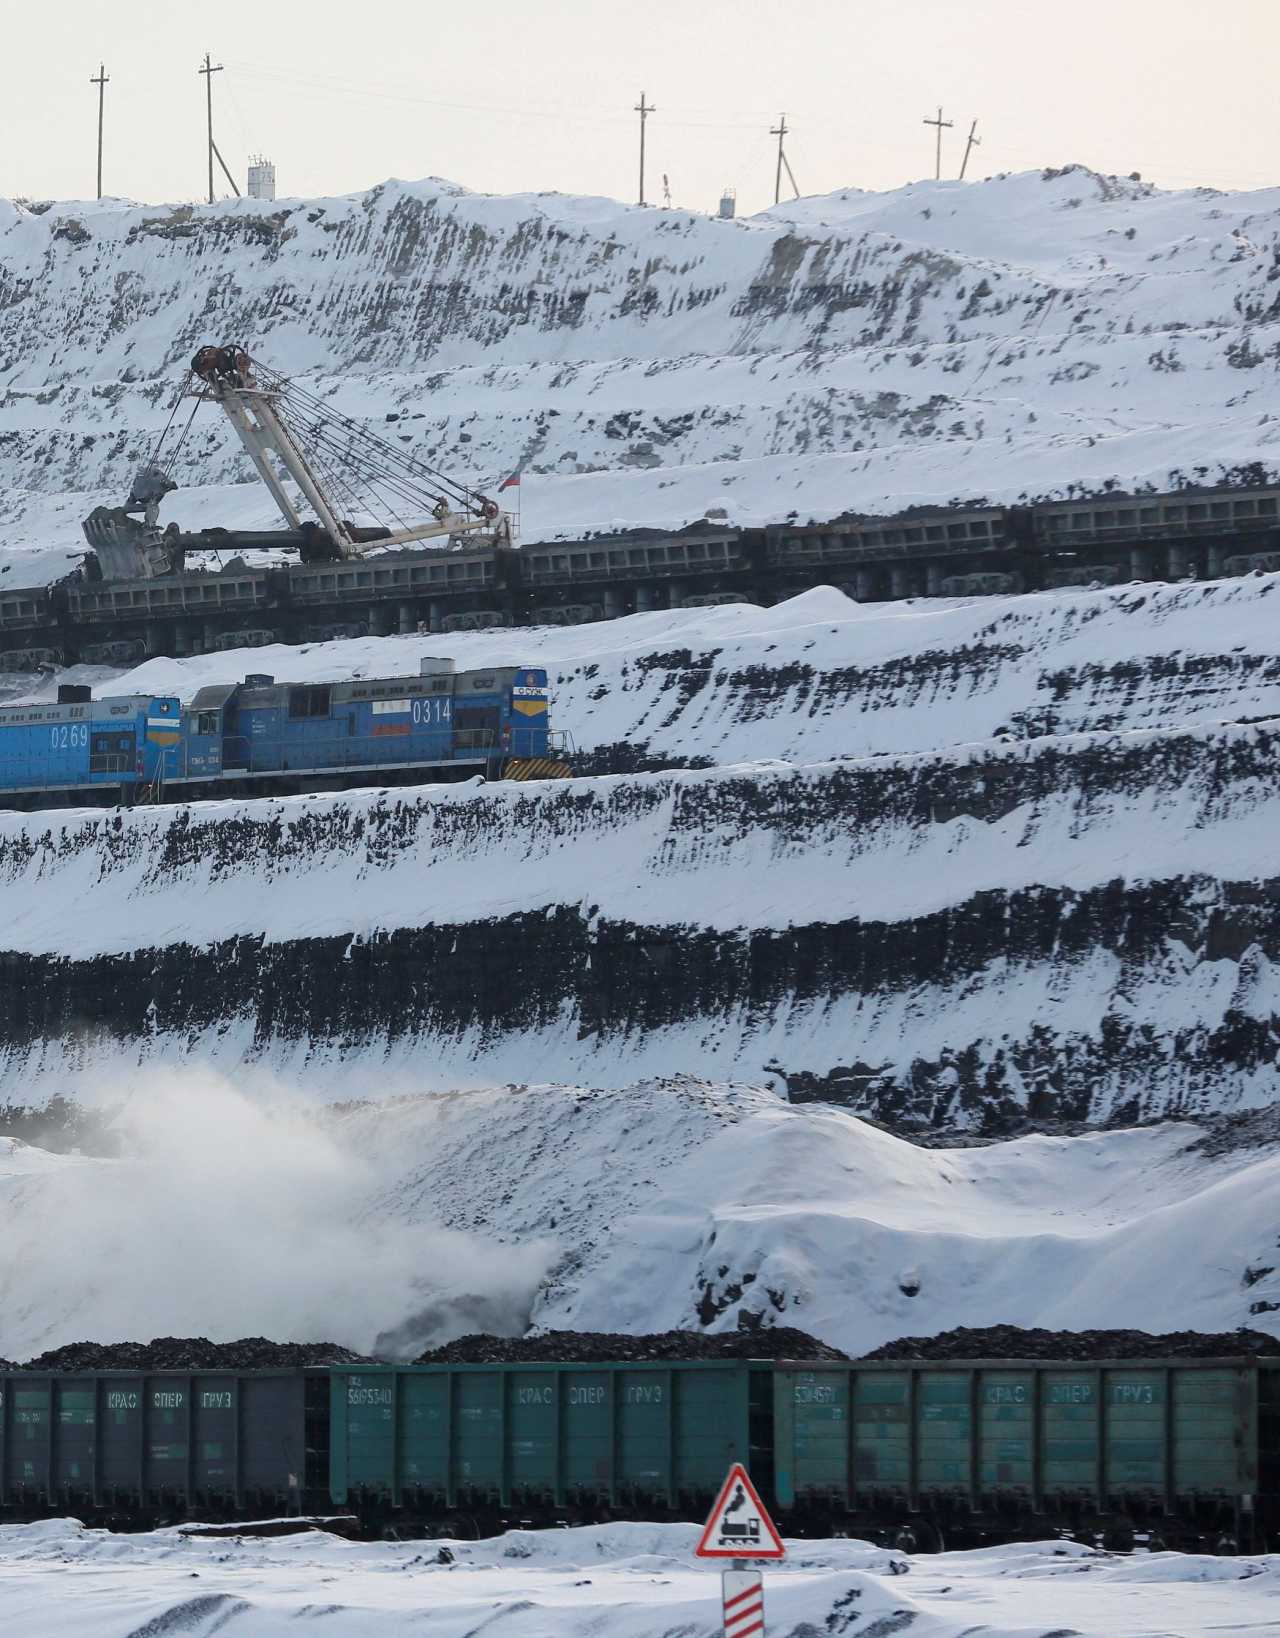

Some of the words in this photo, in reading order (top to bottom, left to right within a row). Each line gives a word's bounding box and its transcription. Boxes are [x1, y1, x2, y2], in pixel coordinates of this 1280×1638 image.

[412, 699, 451, 724] 0314
[51, 725, 88, 748] 0269
[107, 1391, 137, 1409] КРАС
[154, 1391, 183, 1408] ОПЕР
[202, 1391, 232, 1409] ГРУЗ
[519, 1386, 552, 1405] КРАС
